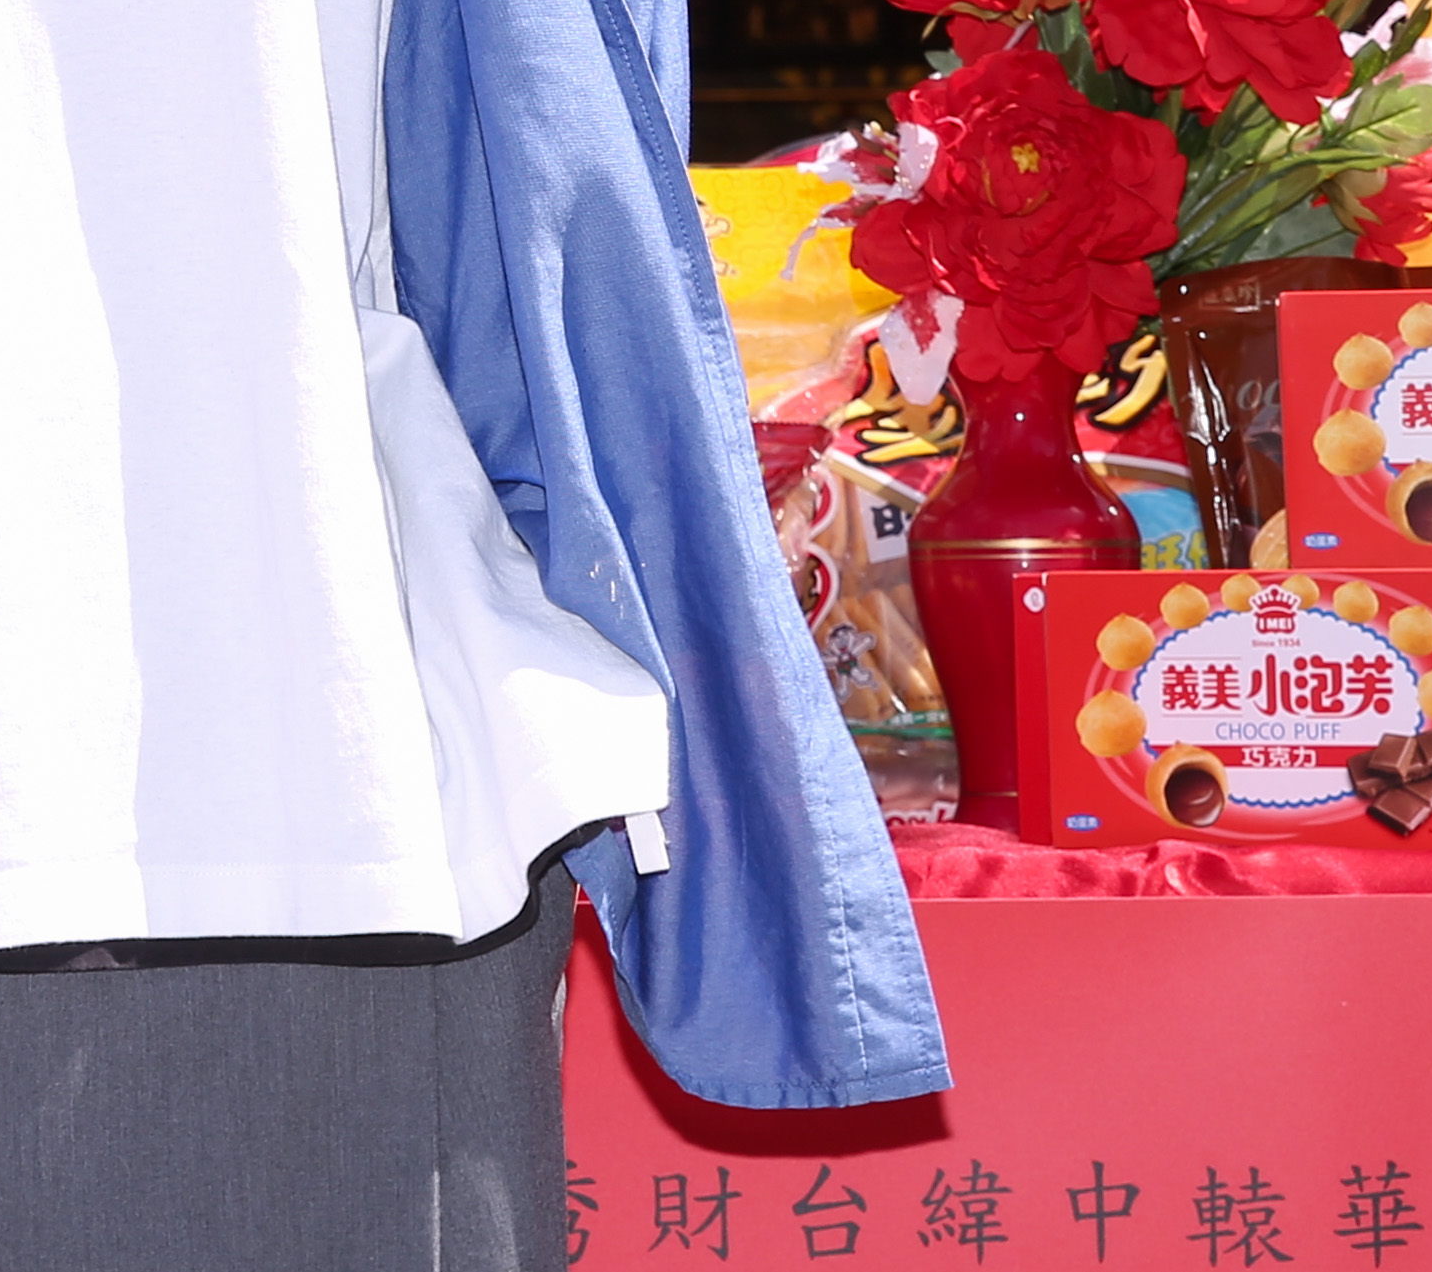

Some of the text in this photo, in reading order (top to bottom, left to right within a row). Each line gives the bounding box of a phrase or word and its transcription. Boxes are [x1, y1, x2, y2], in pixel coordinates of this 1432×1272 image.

[1215, 722, 1342, 741] CHOCO PUFF
[1241, 746, 1318, 767] 巧克力
